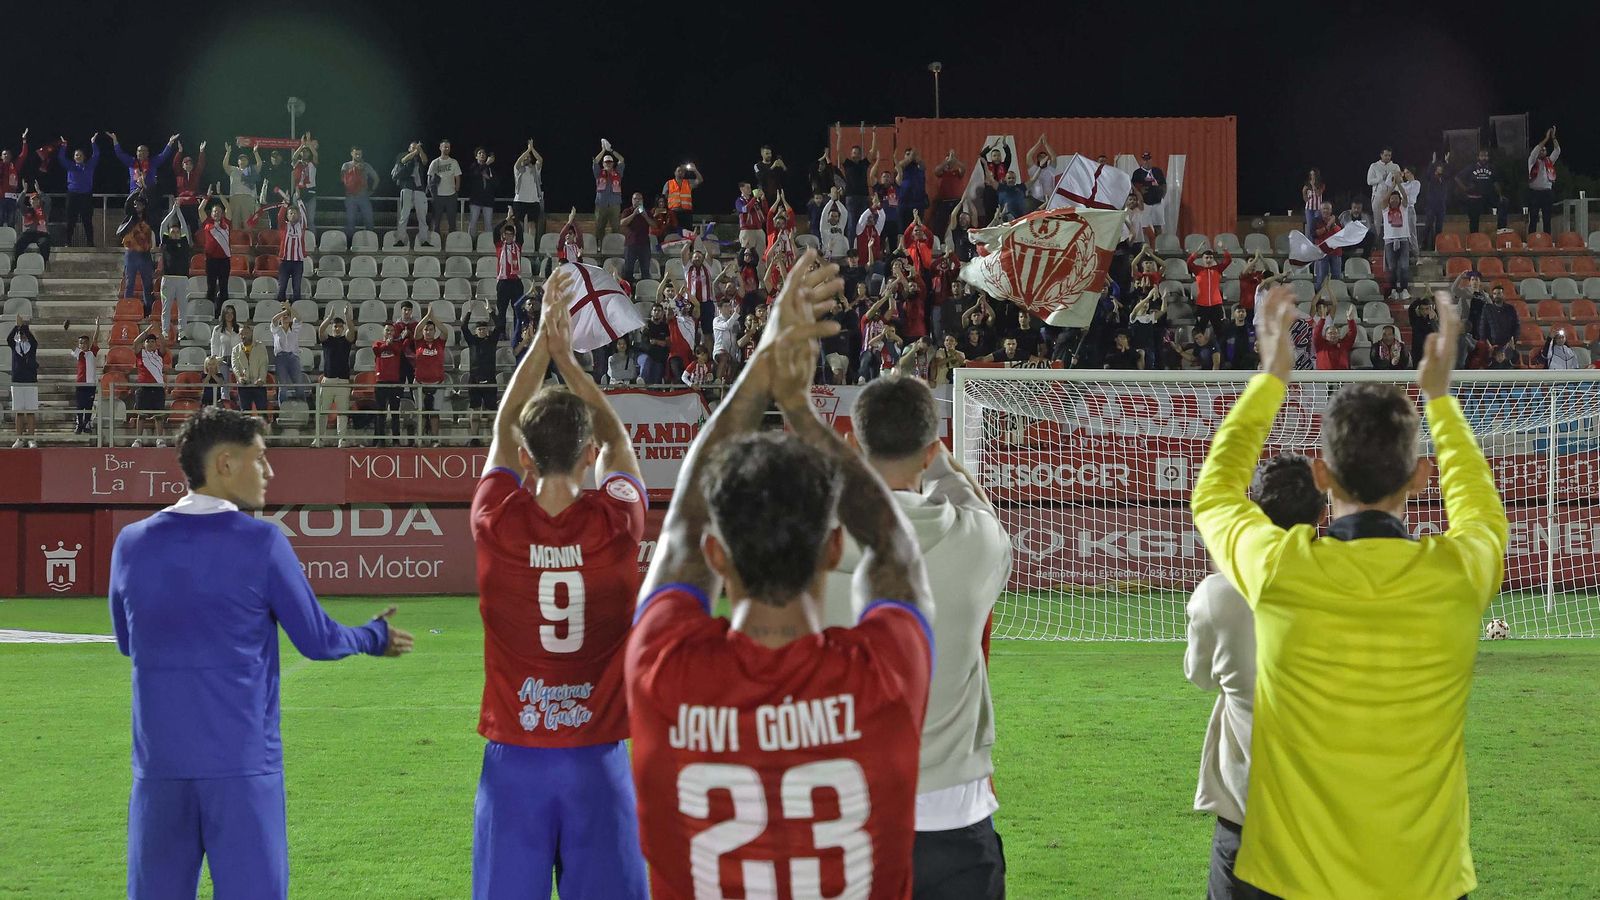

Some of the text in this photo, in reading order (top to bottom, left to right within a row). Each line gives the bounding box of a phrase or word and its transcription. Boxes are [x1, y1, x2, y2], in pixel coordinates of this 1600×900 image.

[105, 453, 136, 471] Bar
[350, 455, 467, 478] MOLINO
[91, 466, 126, 495] La
[359, 554, 443, 578] Motor
[530, 544, 583, 568] MANIN
[538, 570, 586, 653] 9
[669, 694, 861, 752] JAVI GÓMEZ
[677, 758, 874, 900] 23
